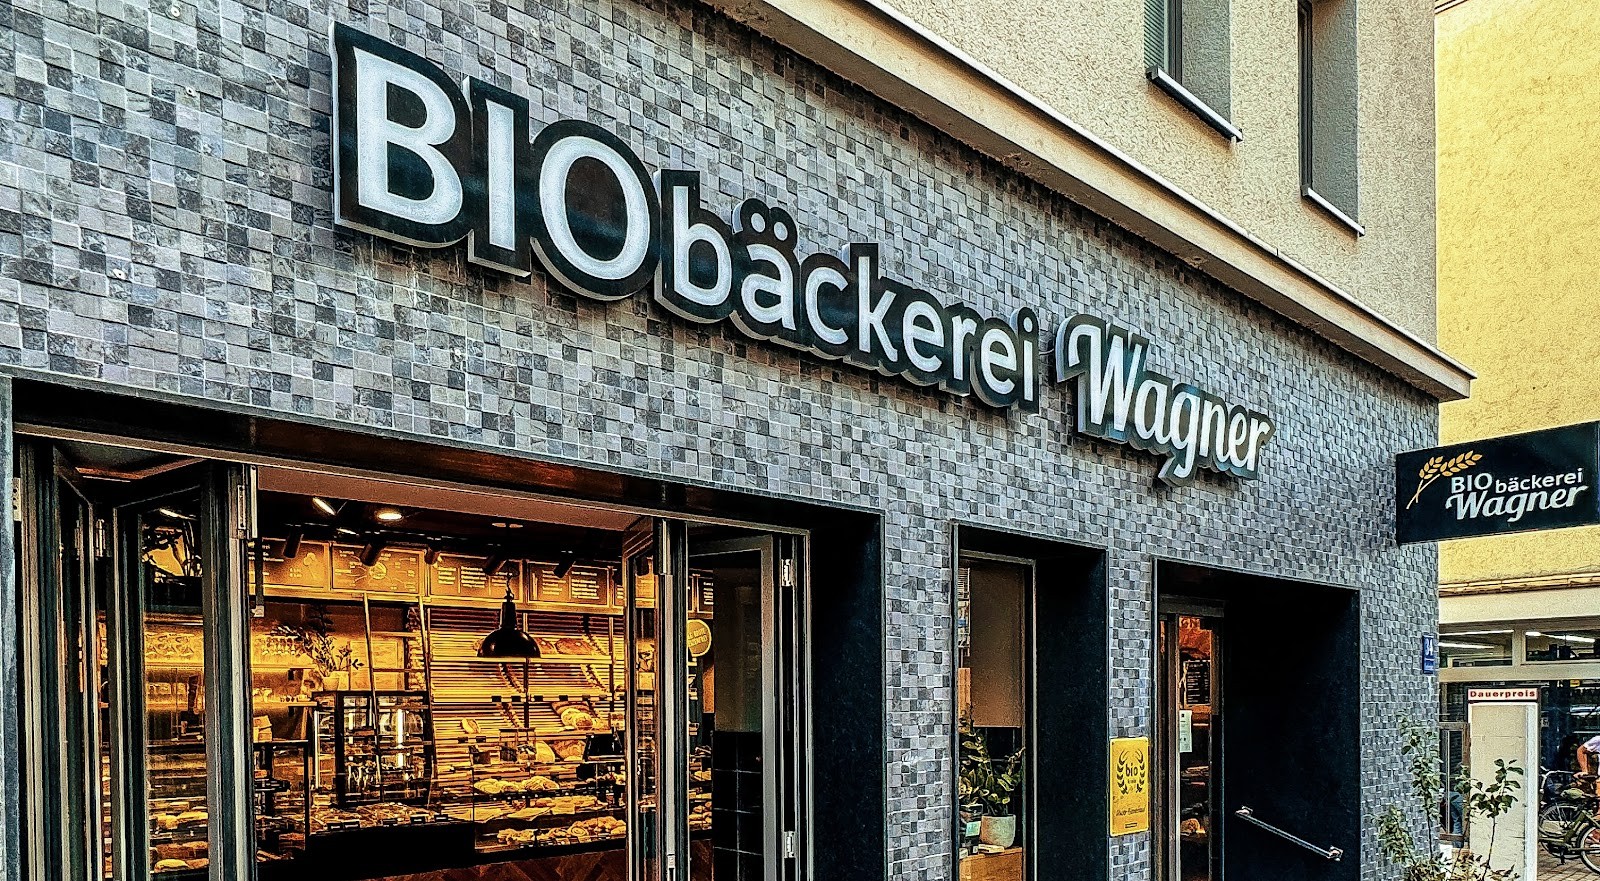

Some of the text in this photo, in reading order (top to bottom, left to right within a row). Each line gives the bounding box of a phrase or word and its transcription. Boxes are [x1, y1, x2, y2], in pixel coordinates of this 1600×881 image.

[1067, 323, 1271, 479] Wagner
[1451, 467, 1584, 494] BIO bäckerei
[1445, 485, 1589, 523] Wagner
[1470, 690, 1536, 699] Dauerpreis
[1125, 762, 1139, 777] bio
